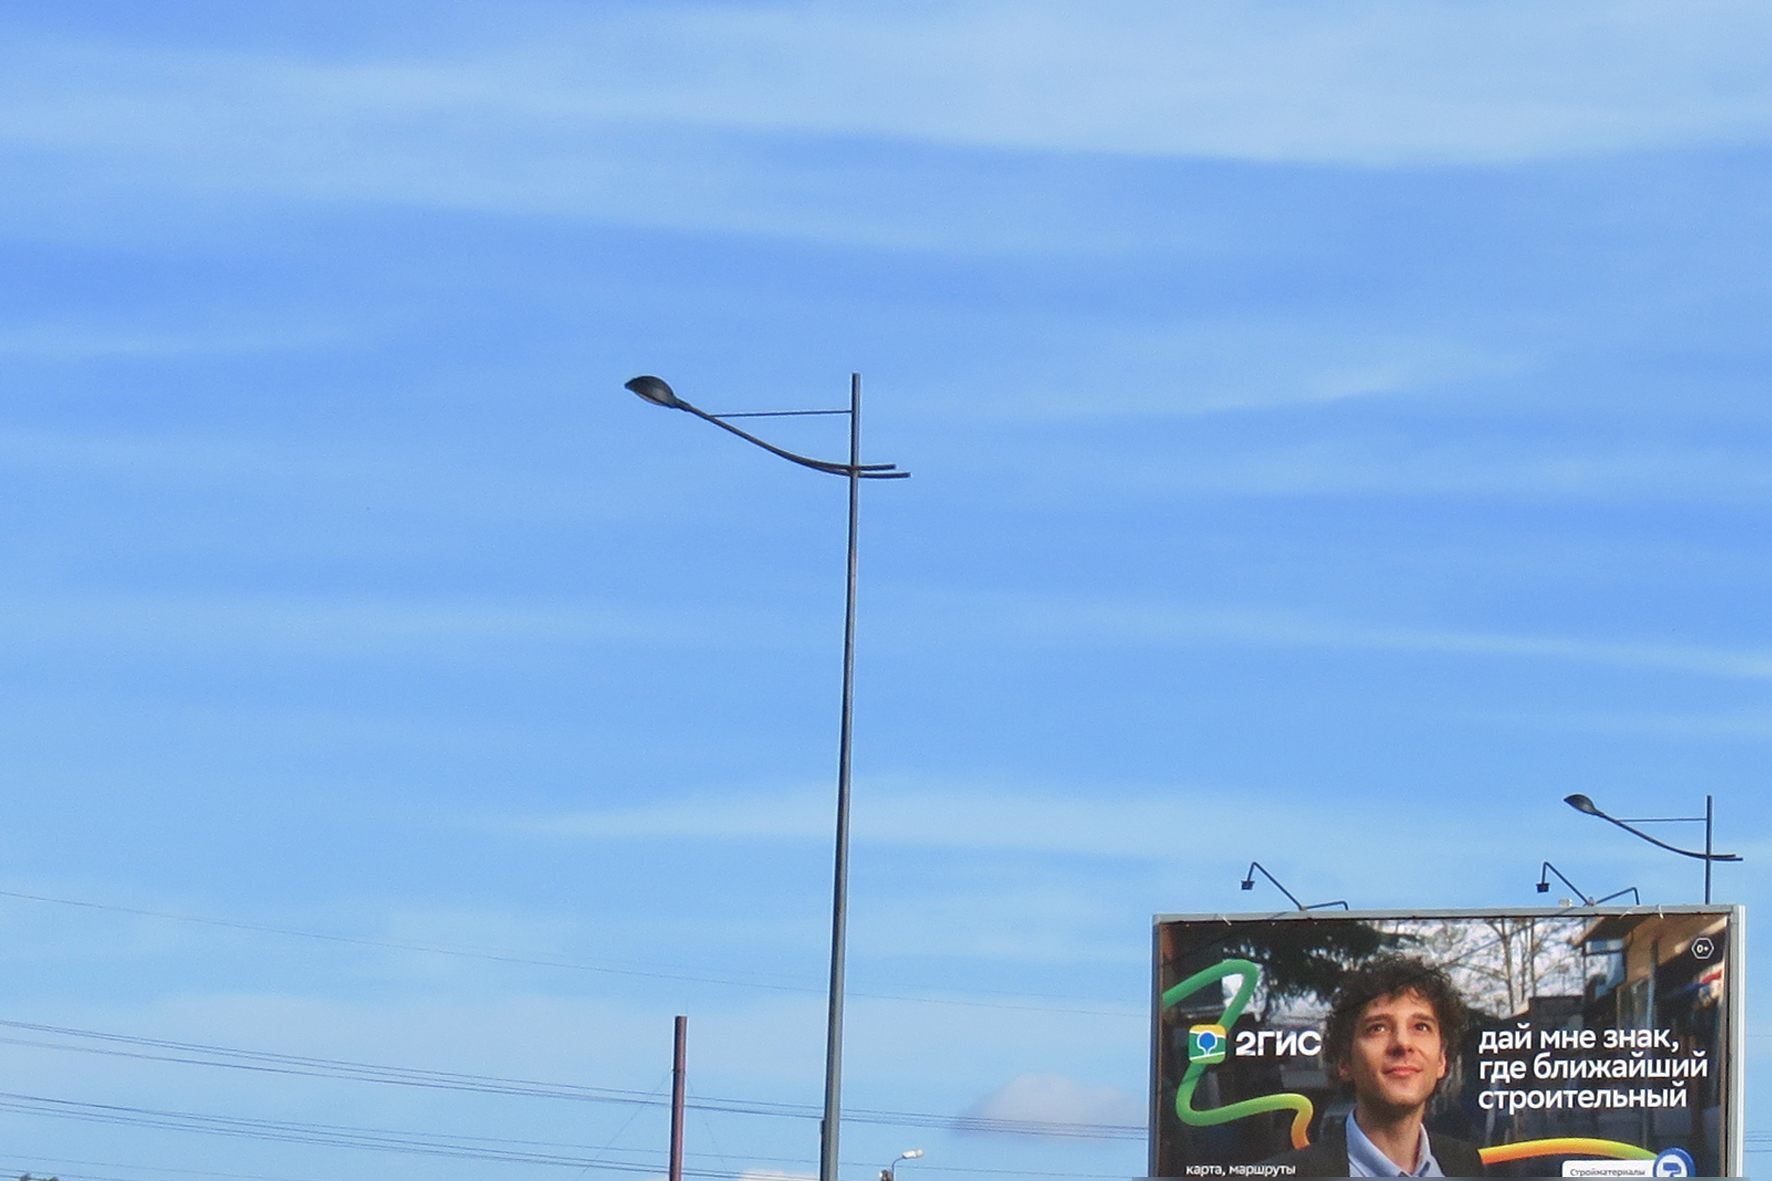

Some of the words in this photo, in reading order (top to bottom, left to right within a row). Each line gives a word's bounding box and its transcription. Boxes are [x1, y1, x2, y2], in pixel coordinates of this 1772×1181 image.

[1235, 1030, 1322, 1056] 2ГИС
[1478, 1023, 1532, 1054] дай
[1540, 1028, 1596, 1049] мне
[1603, 1028, 1679, 1053] знак,
[1479, 1061, 1526, 1083] где
[1533, 1051, 1708, 1079] ближайший
[1477, 1081, 1687, 1115] строительный
[1186, 1165, 1226, 1177] карта,
[1229, 1165, 1296, 1177] маршруты
[1570, 1168, 1646, 1177] Стройматериалы
